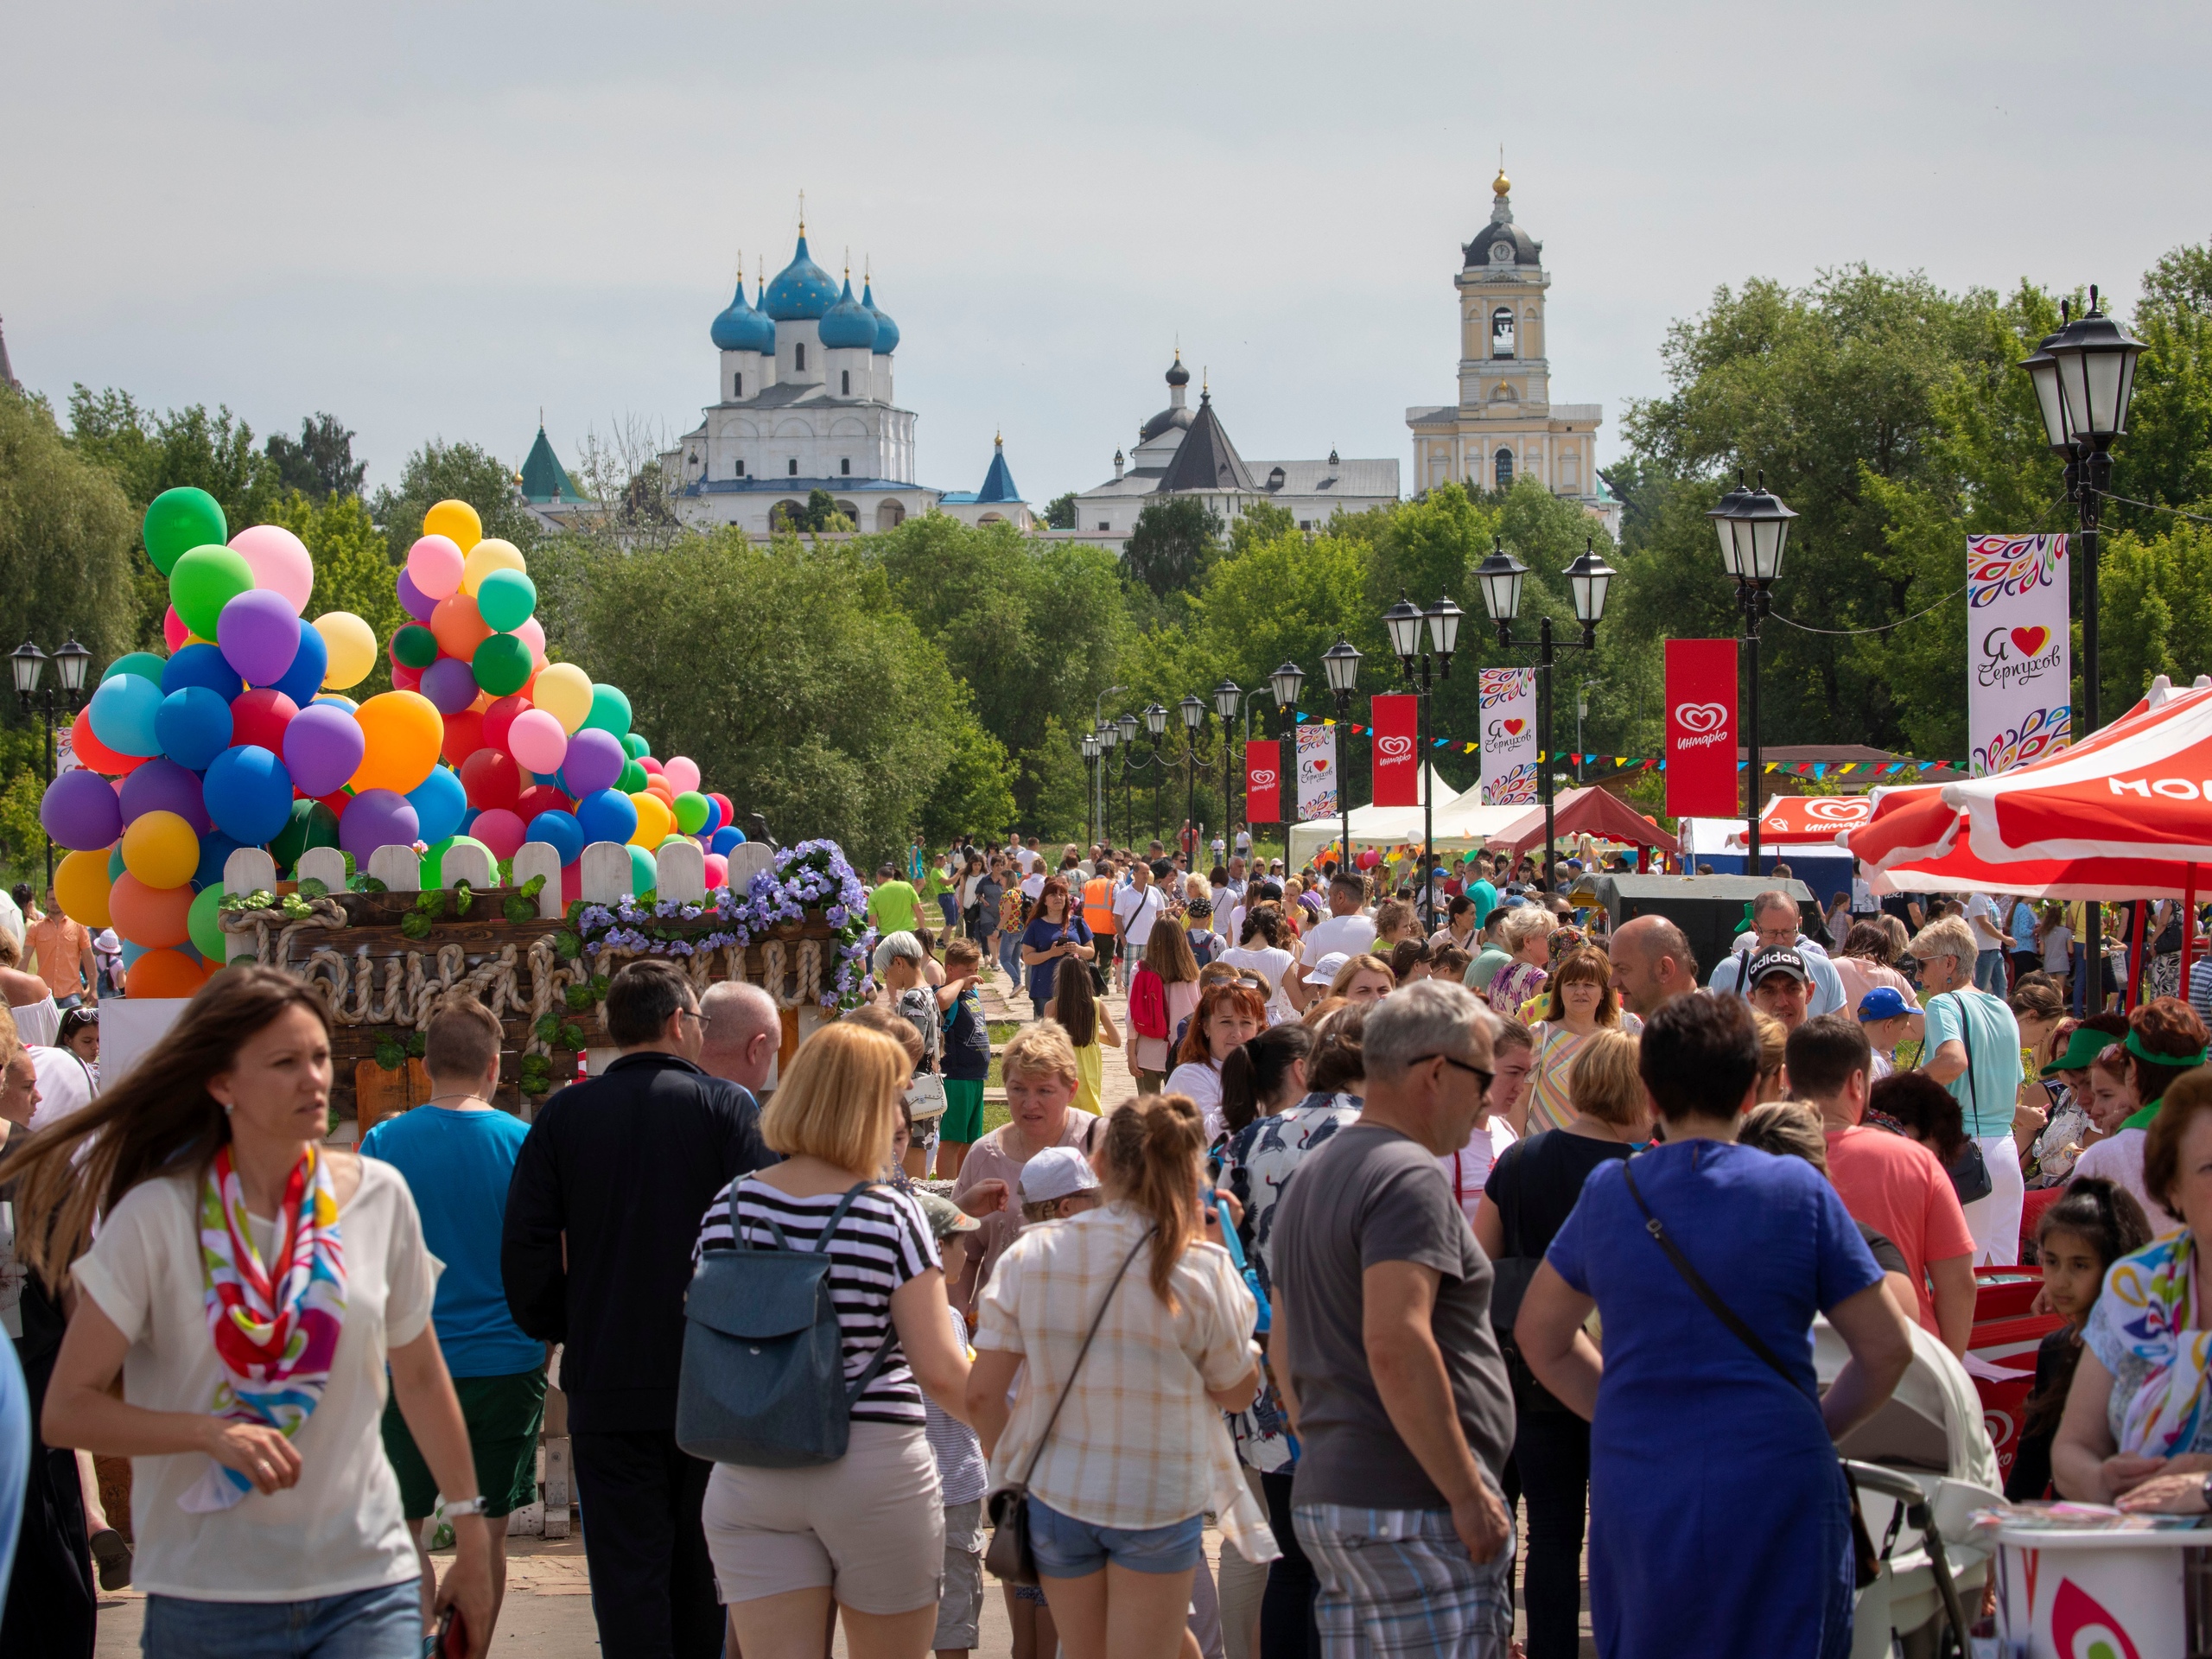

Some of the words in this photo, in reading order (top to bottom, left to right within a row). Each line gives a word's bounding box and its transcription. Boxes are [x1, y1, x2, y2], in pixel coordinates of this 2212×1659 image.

[1983, 626, 2009, 664] Я
[1977, 645, 2061, 689] Серпухов
[1484, 728, 1532, 753] Серпухов
[1488, 719, 1503, 740] Я
[1300, 766, 1333, 784] Серпухов
[1302, 760, 1313, 775] Я
[2108, 777, 2212, 802] МО
[1750, 951, 1801, 975] adidas
